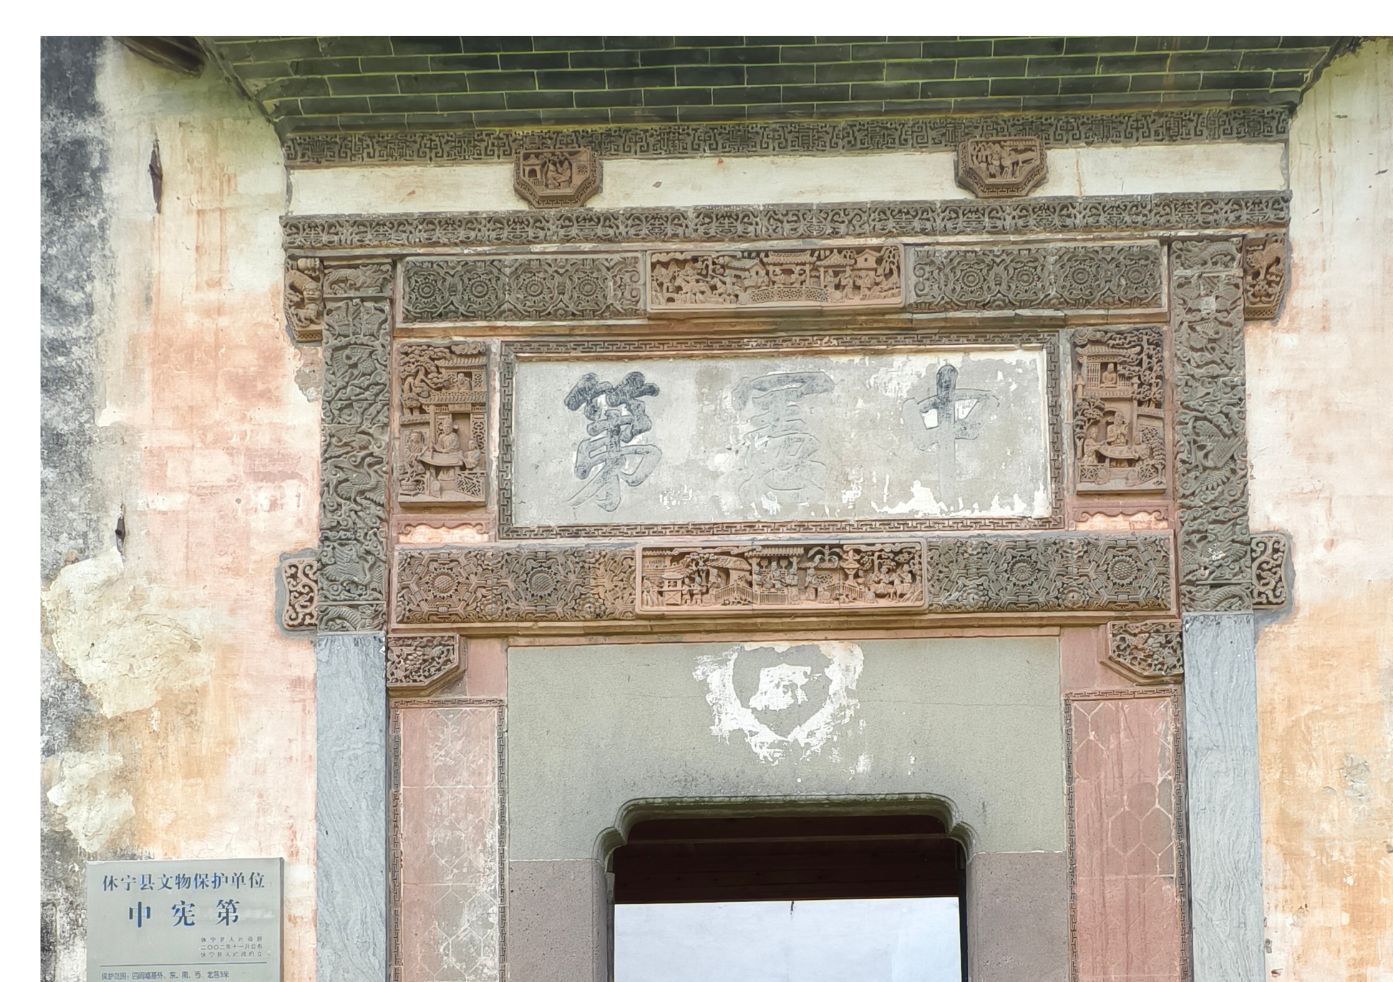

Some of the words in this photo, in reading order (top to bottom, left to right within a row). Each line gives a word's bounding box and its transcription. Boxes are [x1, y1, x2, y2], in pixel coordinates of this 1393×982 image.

[103, 871, 266, 891] 休宁县文物保护单位
[128, 899, 241, 928] 中宪第
